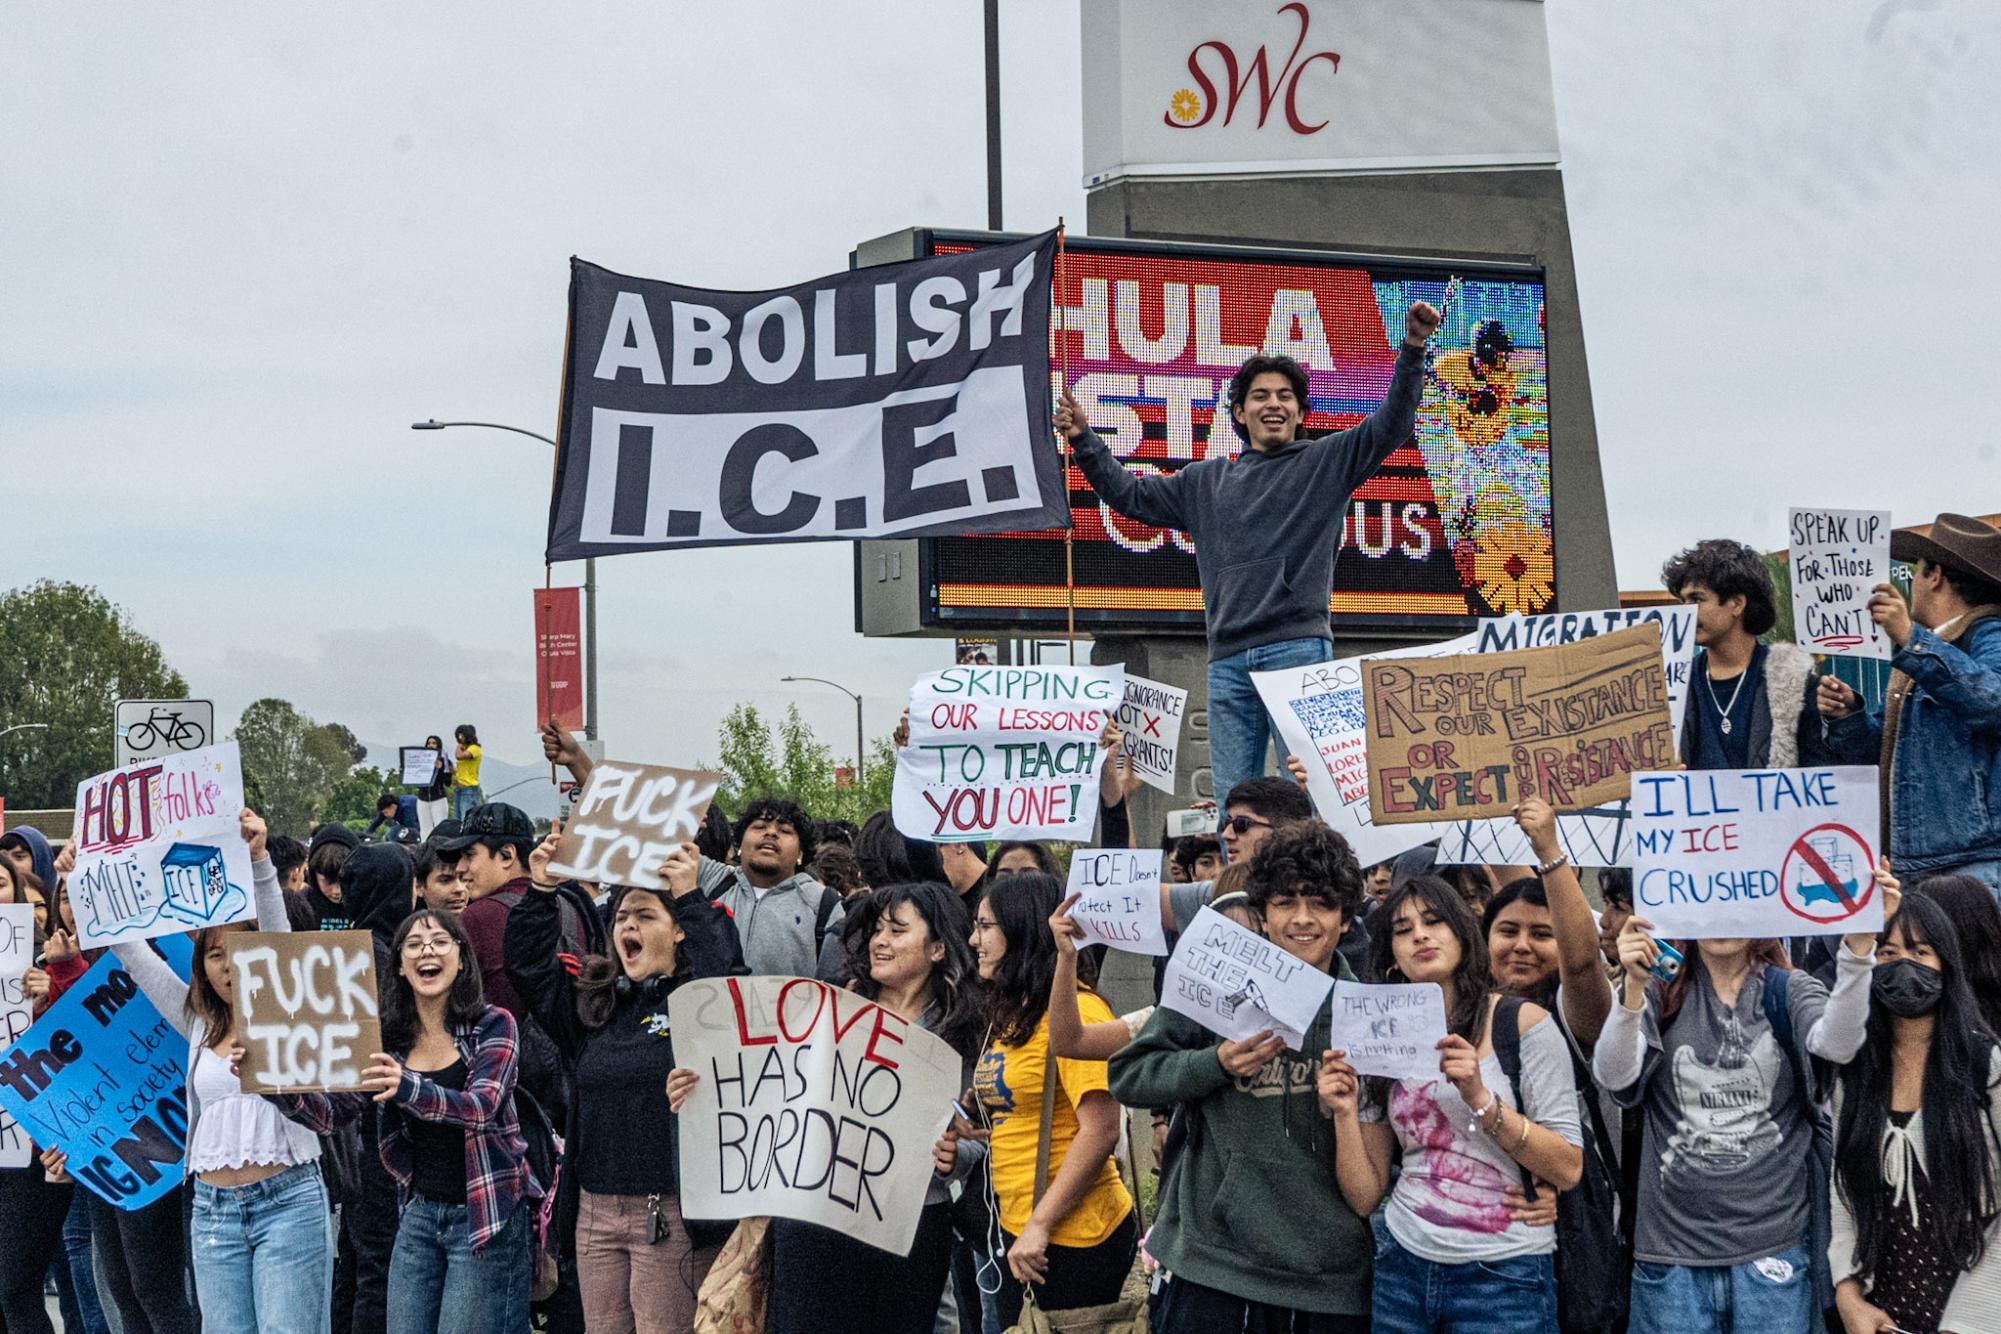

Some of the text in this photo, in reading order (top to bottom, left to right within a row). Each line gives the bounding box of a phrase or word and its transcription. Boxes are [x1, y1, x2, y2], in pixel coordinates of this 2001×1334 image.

[1164, 3, 1341, 134] SWC
[594, 251, 1035, 385] ABOLISH
[611, 393, 1021, 537] I.C.E.
[1794, 512, 1850, 546] SPEAK
[1796, 553, 1874, 585] FOR THOSE
[1816, 583, 1853, 604] WHO
[932, 668, 1114, 701] SKIPPING
[1372, 665, 1526, 738] RESPECT
[1435, 664, 1666, 741] OUR EXISTANCE
[931, 703, 1101, 732] OUR LESSONS
[920, 742, 1097, 783] TO TEACH
[1321, 738, 1362, 756] JUAN
[1407, 741, 1460, 770] OR
[81, 765, 215, 846] HOT folks
[579, 765, 720, 838] FUCK
[922, 784, 1081, 835] YOU ONE!
[1379, 764, 1510, 813] EXPECT
[1640, 771, 1839, 817] I'LL TAKE
[546, 824, 684, 889] ICE
[1637, 823, 1739, 857] MY ICE
[85, 859, 199, 926] MELT ICE
[1079, 853, 1123, 887] ICE
[1640, 868, 1779, 906] CRUSHED
[1090, 917, 1141, 942] KILLS
[1203, 923, 1305, 983] MELT
[233, 945, 379, 1019] FUCK
[1186, 946, 1248, 991] THE
[726, 977, 909, 1069] LOVE
[1178, 974, 1236, 1021] ICE
[1342, 991, 1428, 1017] THE WRONG
[0, 1029, 83, 1102] the
[246, 1023, 360, 1089] ICE
[712, 1045, 812, 1110] HAS
[831, 1050, 901, 1117] NO
[28, 1063, 122, 1141] Violent
[88, 1057, 188, 1148] in society
[718, 1108, 895, 1221] BORDER
